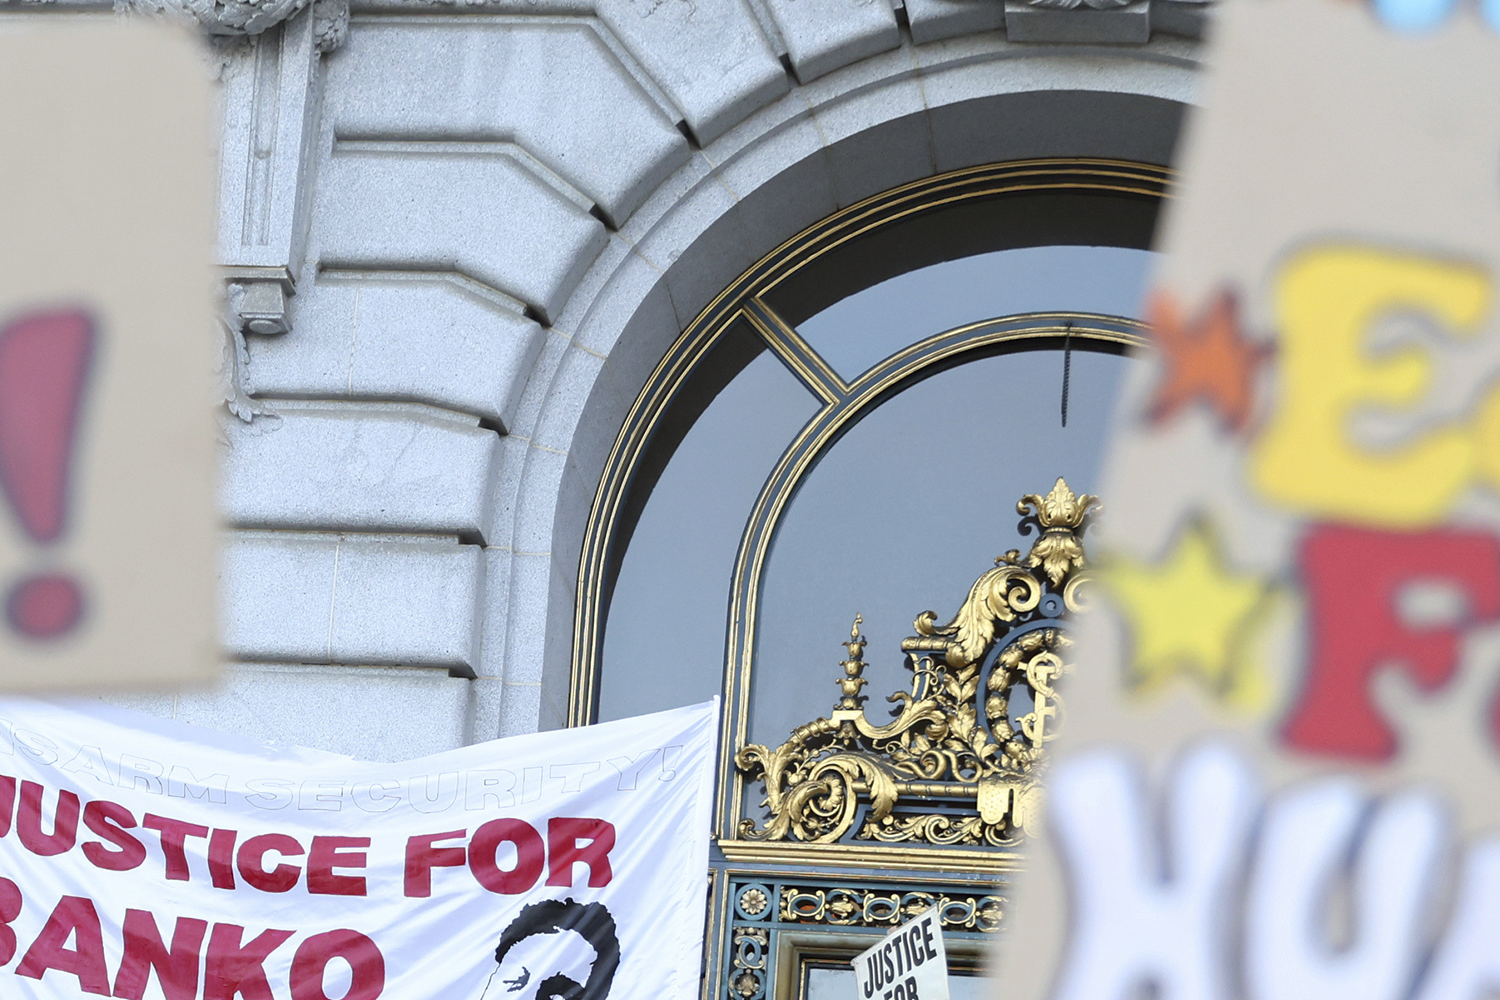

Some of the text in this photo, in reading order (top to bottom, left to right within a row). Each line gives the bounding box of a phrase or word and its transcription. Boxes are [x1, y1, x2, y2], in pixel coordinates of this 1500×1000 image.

[244, 744, 685, 815] SECURITY!
[402, 816, 617, 899] FOR
[863, 916, 938, 999] JUSTICE
